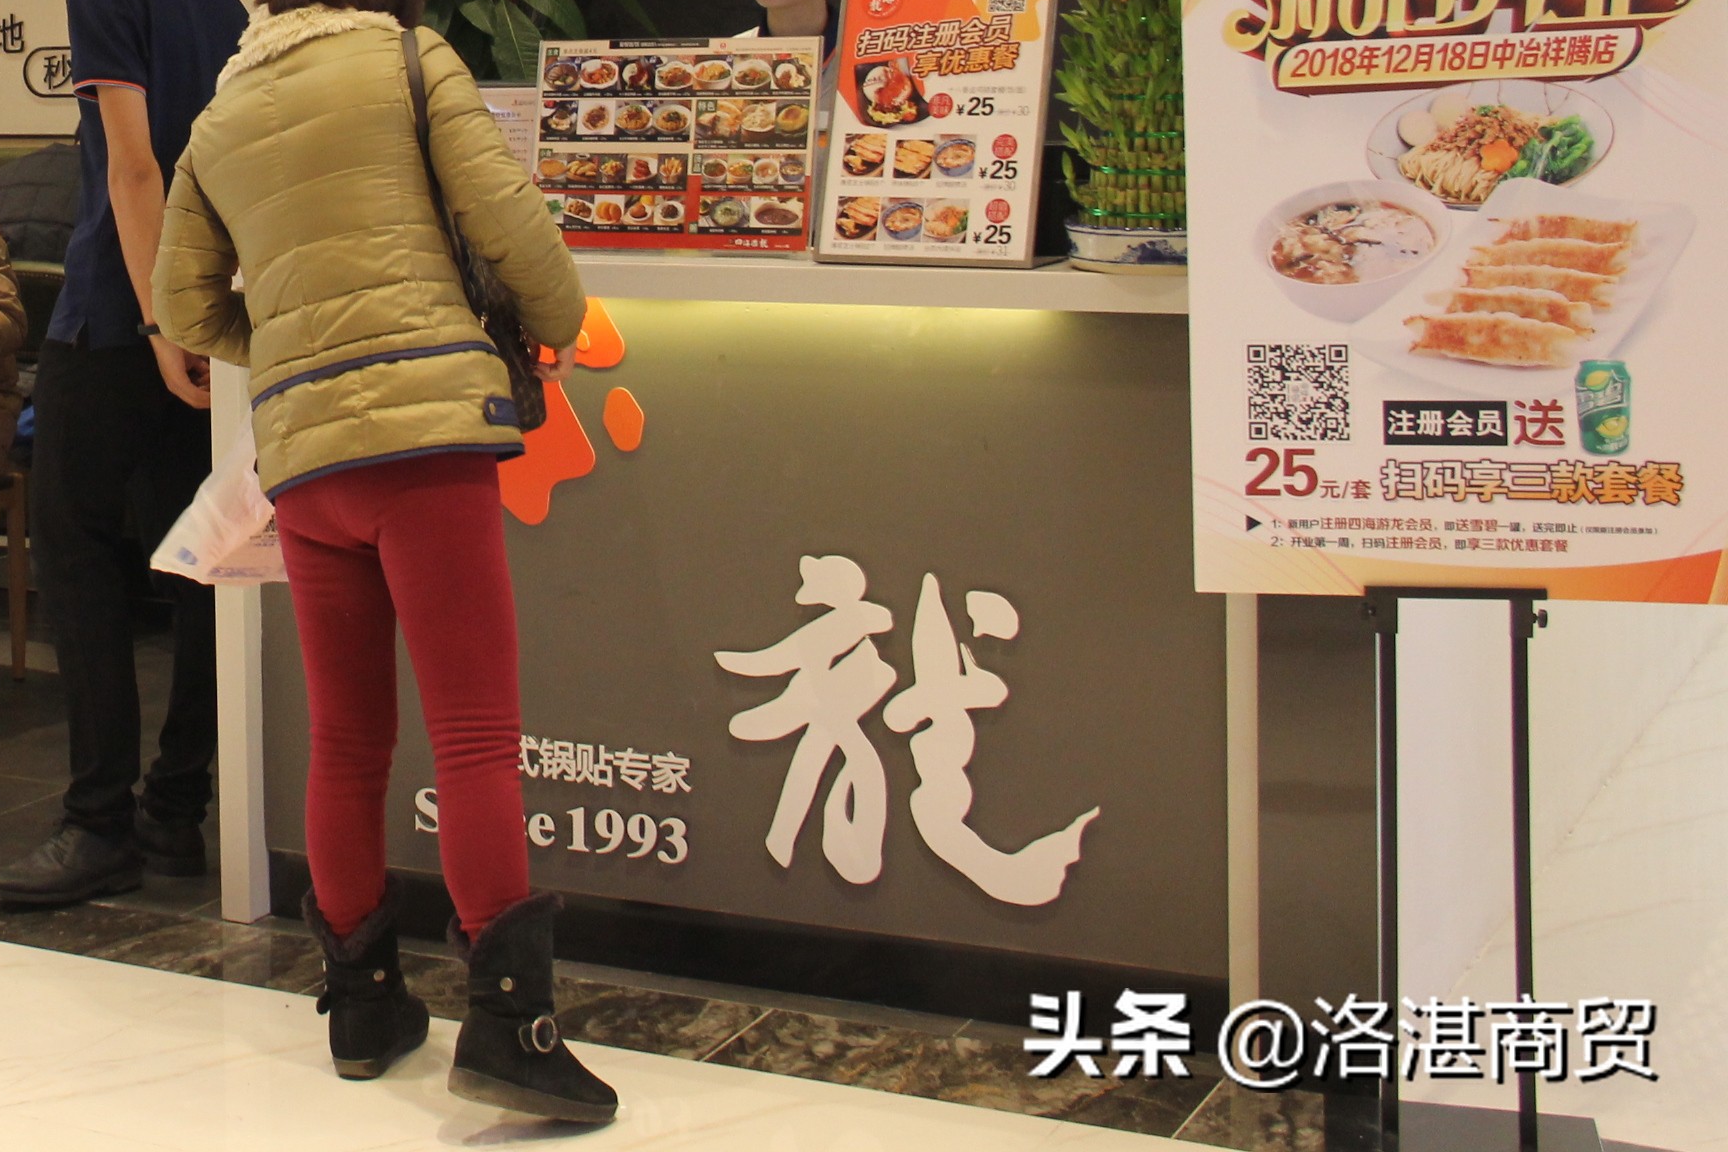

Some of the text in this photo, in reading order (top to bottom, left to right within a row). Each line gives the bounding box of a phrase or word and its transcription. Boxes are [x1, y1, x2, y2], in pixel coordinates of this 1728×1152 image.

[856, 14, 1013, 59] 扫码注册会员
[912, 41, 1021, 78] 享优惠餐
[1288, 32, 1619, 81] 2018年12月18日中冶祥腾店
[956, 96, 995, 117] ¥25
[978, 160, 1018, 180] ¥25
[973, 225, 1012, 245] ¥25
[1387, 399, 1566, 447] 注册会员 送
[1381, 458, 1684, 508] 扫码享三款套餐
[517, 734, 692, 794] 式锅贴专家
[565, 806, 689, 865] 1993
